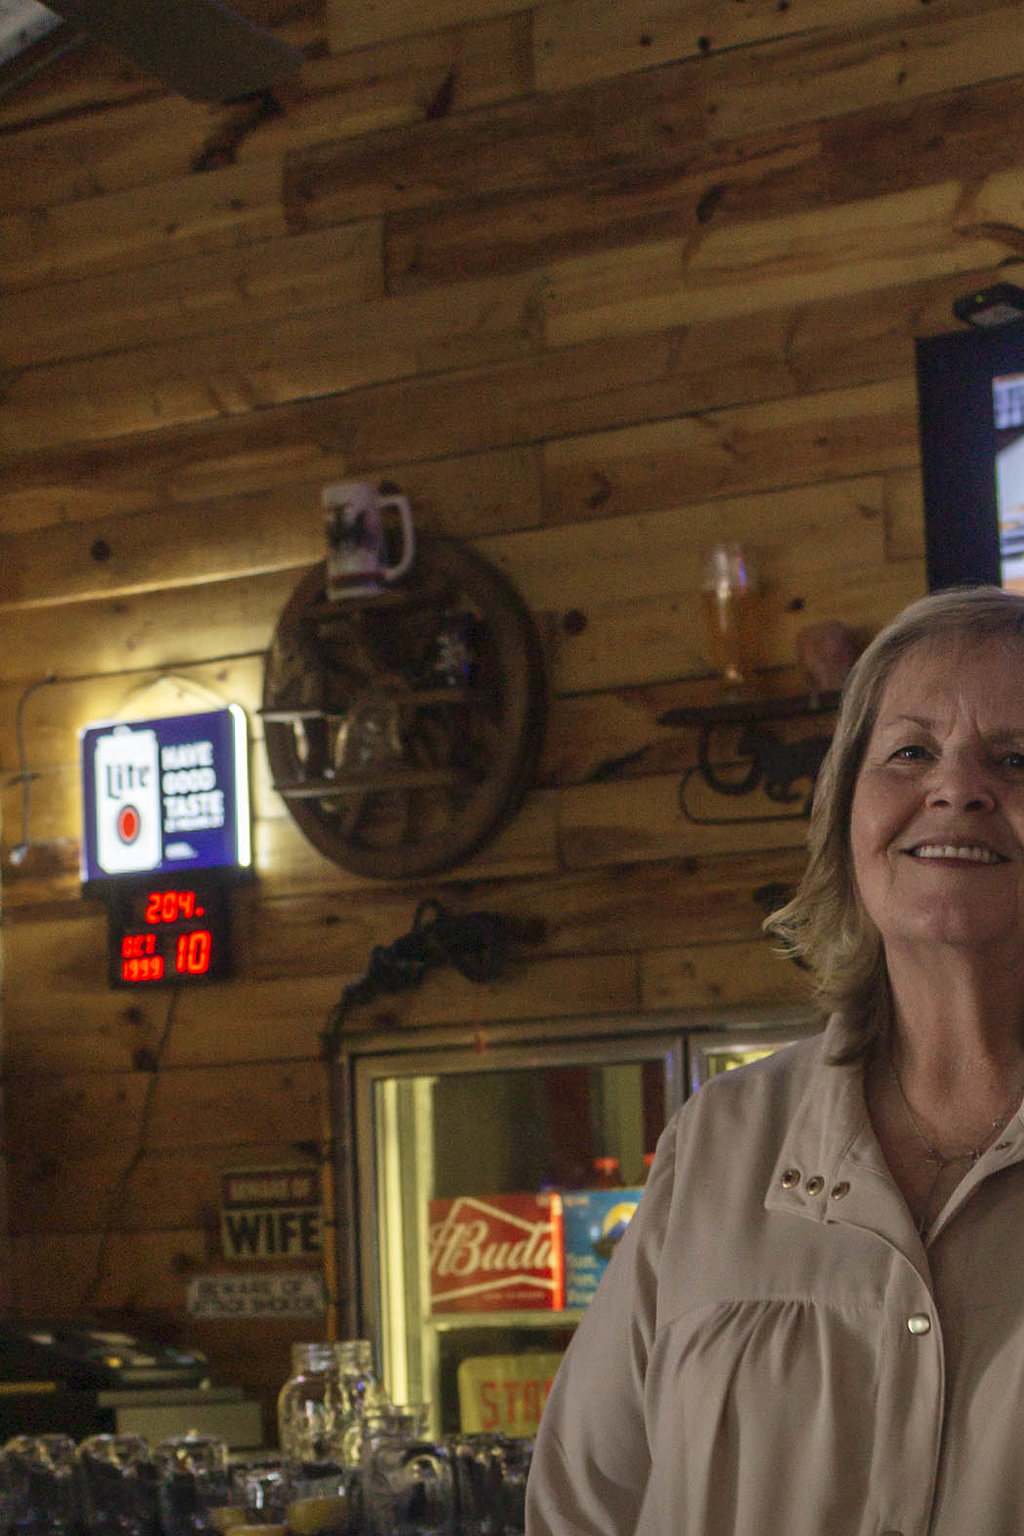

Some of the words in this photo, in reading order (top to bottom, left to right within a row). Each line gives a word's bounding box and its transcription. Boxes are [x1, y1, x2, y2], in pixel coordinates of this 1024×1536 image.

[122, 955, 164, 982] 1999
[176, 930, 212, 975] 10
[225, 1212, 321, 1255] WIFE
